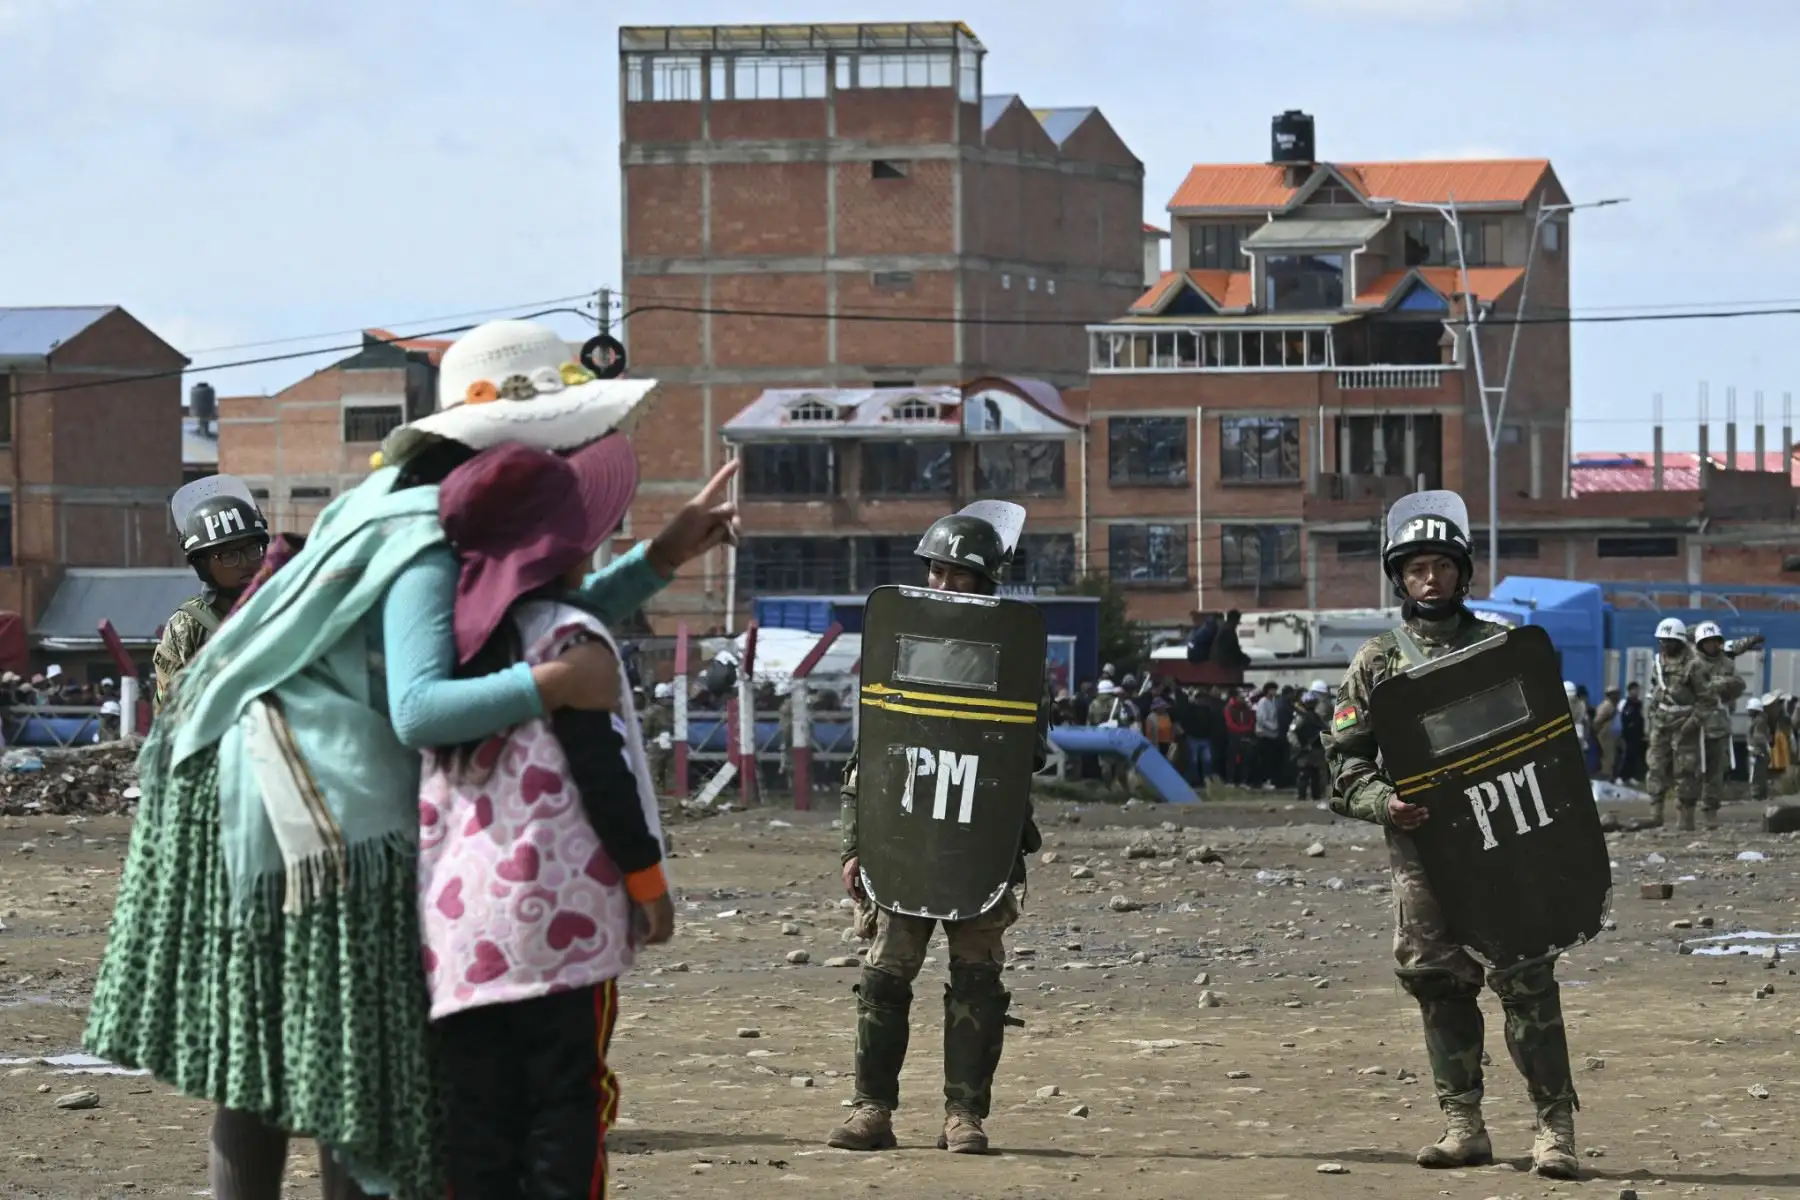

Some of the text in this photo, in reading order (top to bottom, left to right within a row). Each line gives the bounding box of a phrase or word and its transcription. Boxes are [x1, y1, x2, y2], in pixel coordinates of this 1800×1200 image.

[204, 508, 245, 541] PM
[1402, 519, 1447, 541] PM
[901, 746, 979, 823] PM
[1464, 761, 1554, 851] PM
